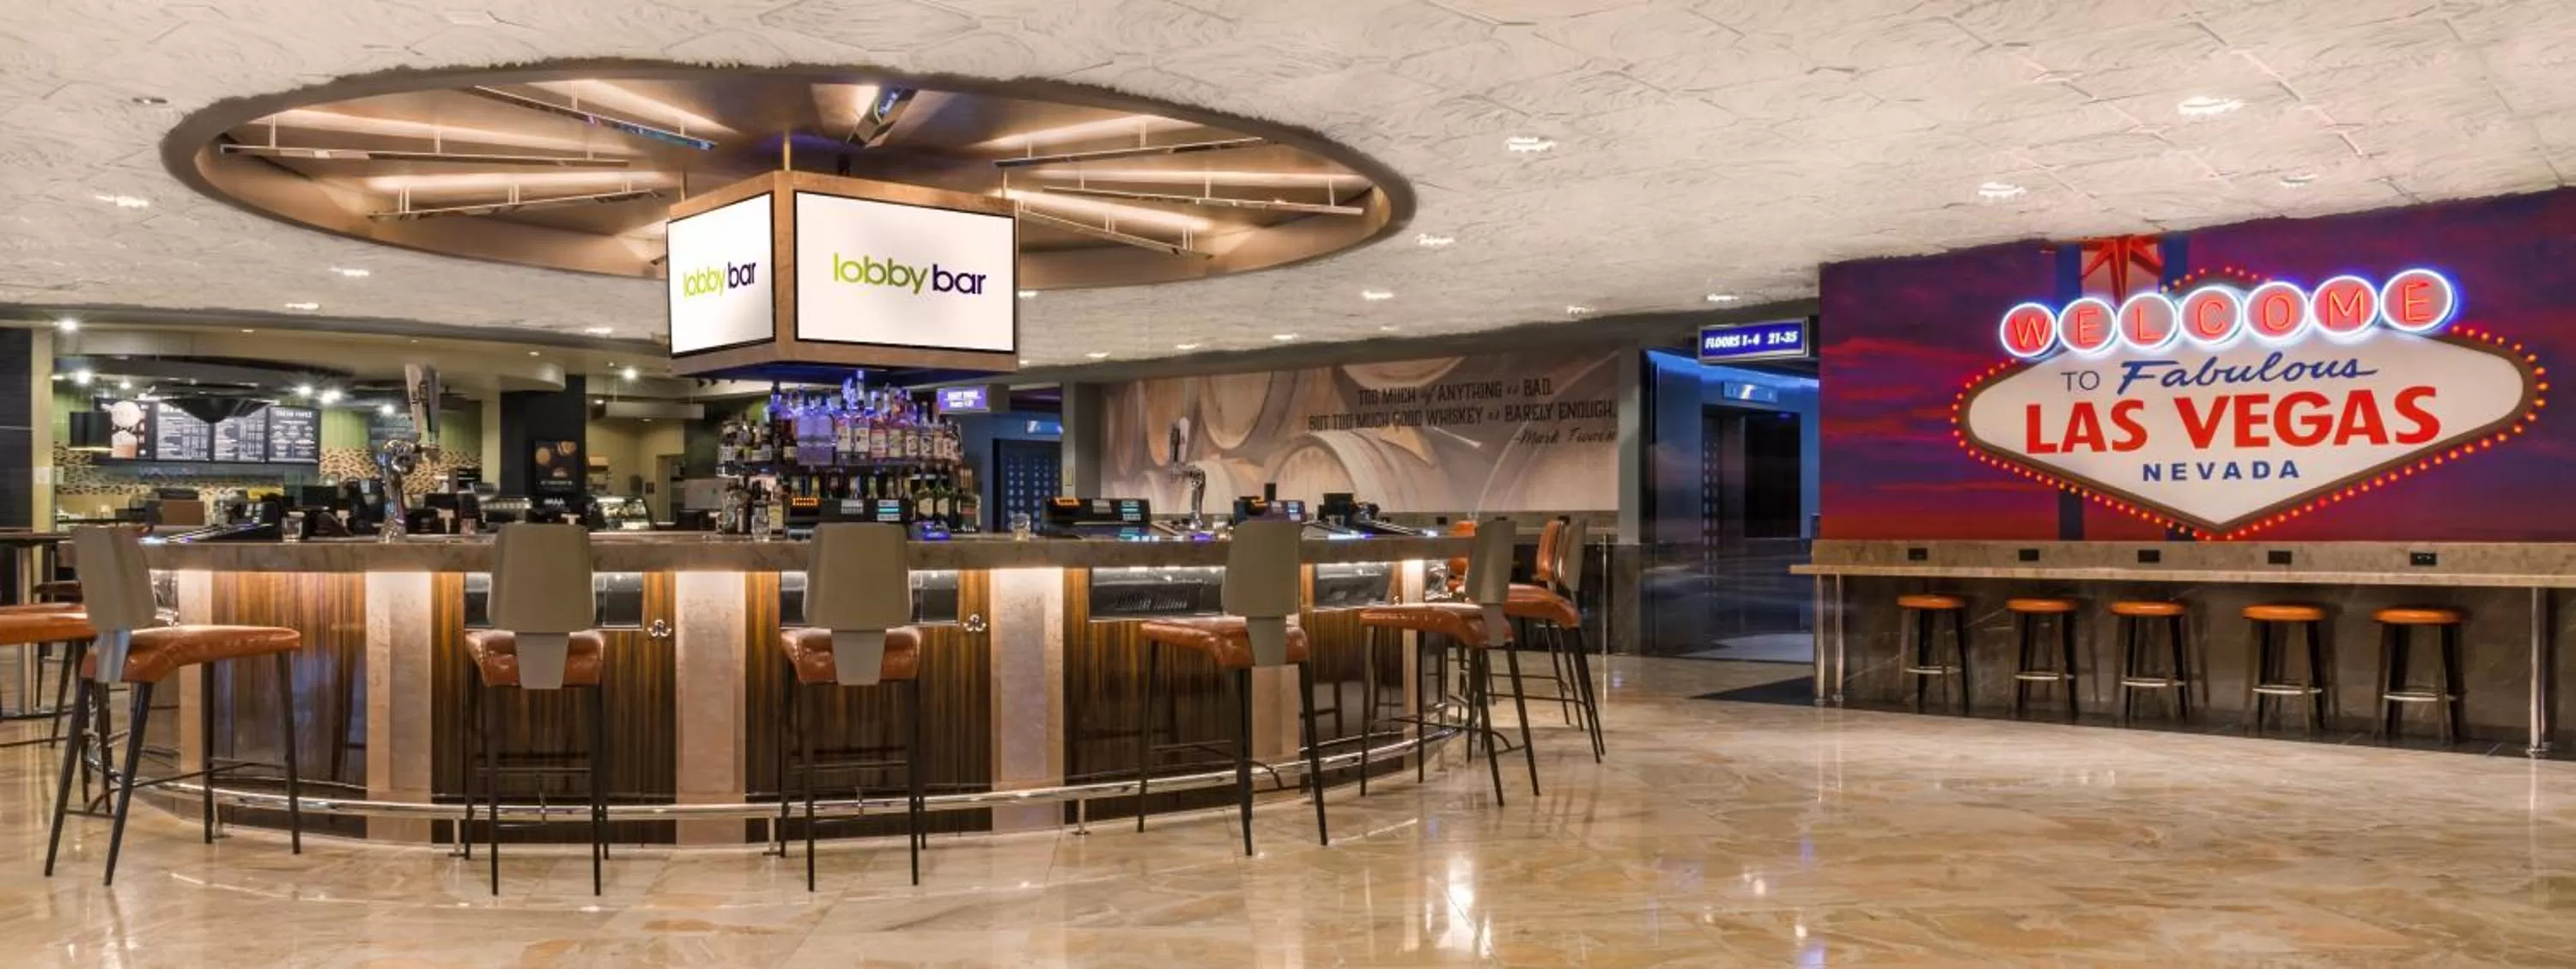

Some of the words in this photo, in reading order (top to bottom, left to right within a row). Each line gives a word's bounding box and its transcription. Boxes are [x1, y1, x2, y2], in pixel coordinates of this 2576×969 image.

[683, 265, 726, 297] lobby
[727, 260, 756, 289] bar
[833, 253, 928, 295] lobby
[933, 264, 987, 295] bar
[2009, 280, 2433, 348] WELCOME
[1704, 334, 1741, 349] FLOORS
[1741, 332, 1761, 346] 1-4
[2060, 370, 2100, 393] TO
[2117, 350, 2378, 396] Fabulous
[1358, 389, 1378, 406] TOO
[1382, 387, 1417, 405] MUCH
[1437, 381, 1503, 403] ANYTHING
[1308, 415, 1329, 431] BUT
[1333, 413, 1354, 430] TOO
[1356, 411, 1389, 430] MUCH
[1393, 409, 1422, 432] GOOD
[1426, 406, 1485, 427] WHISKEY
[1504, 403, 1553, 424] BARELY
[1558, 399, 1618, 420] ENOUGH.
[2026, 398, 2148, 454] LAS
[2173, 385, 2441, 450] VEGAS
[2142, 459, 2300, 482] NEVADA
